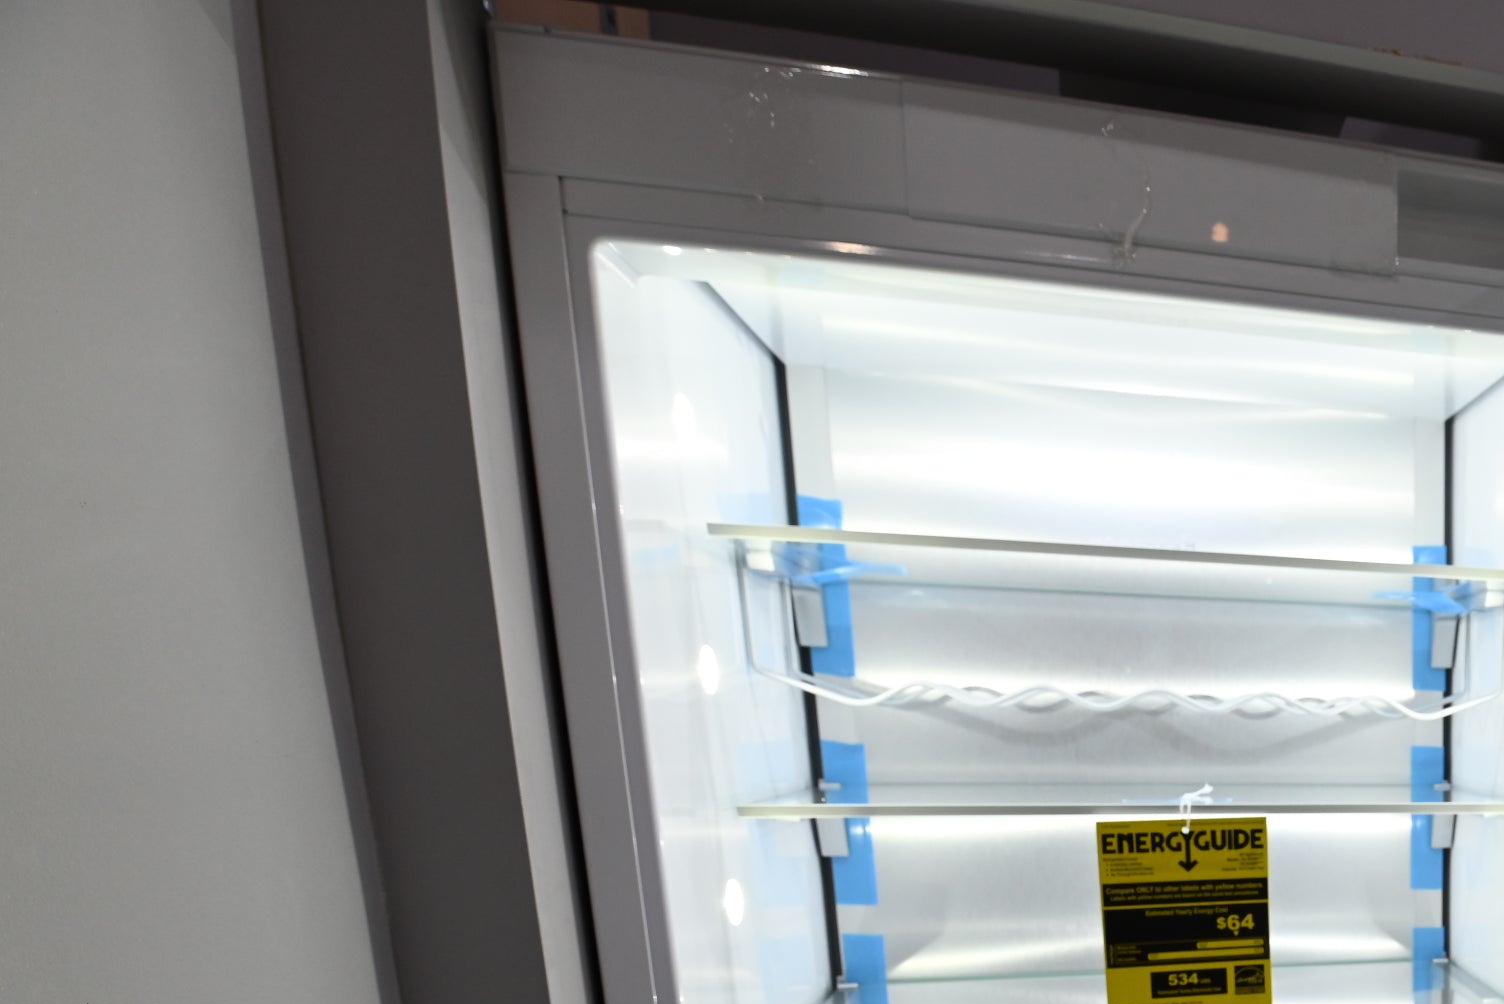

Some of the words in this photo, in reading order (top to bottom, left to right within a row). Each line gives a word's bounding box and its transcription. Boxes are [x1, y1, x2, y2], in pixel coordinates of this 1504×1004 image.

[1136, 886, 1154, 894] ONLY
[1216, 913, 1255, 931] $64
[1168, 972, 1199, 986] 534
